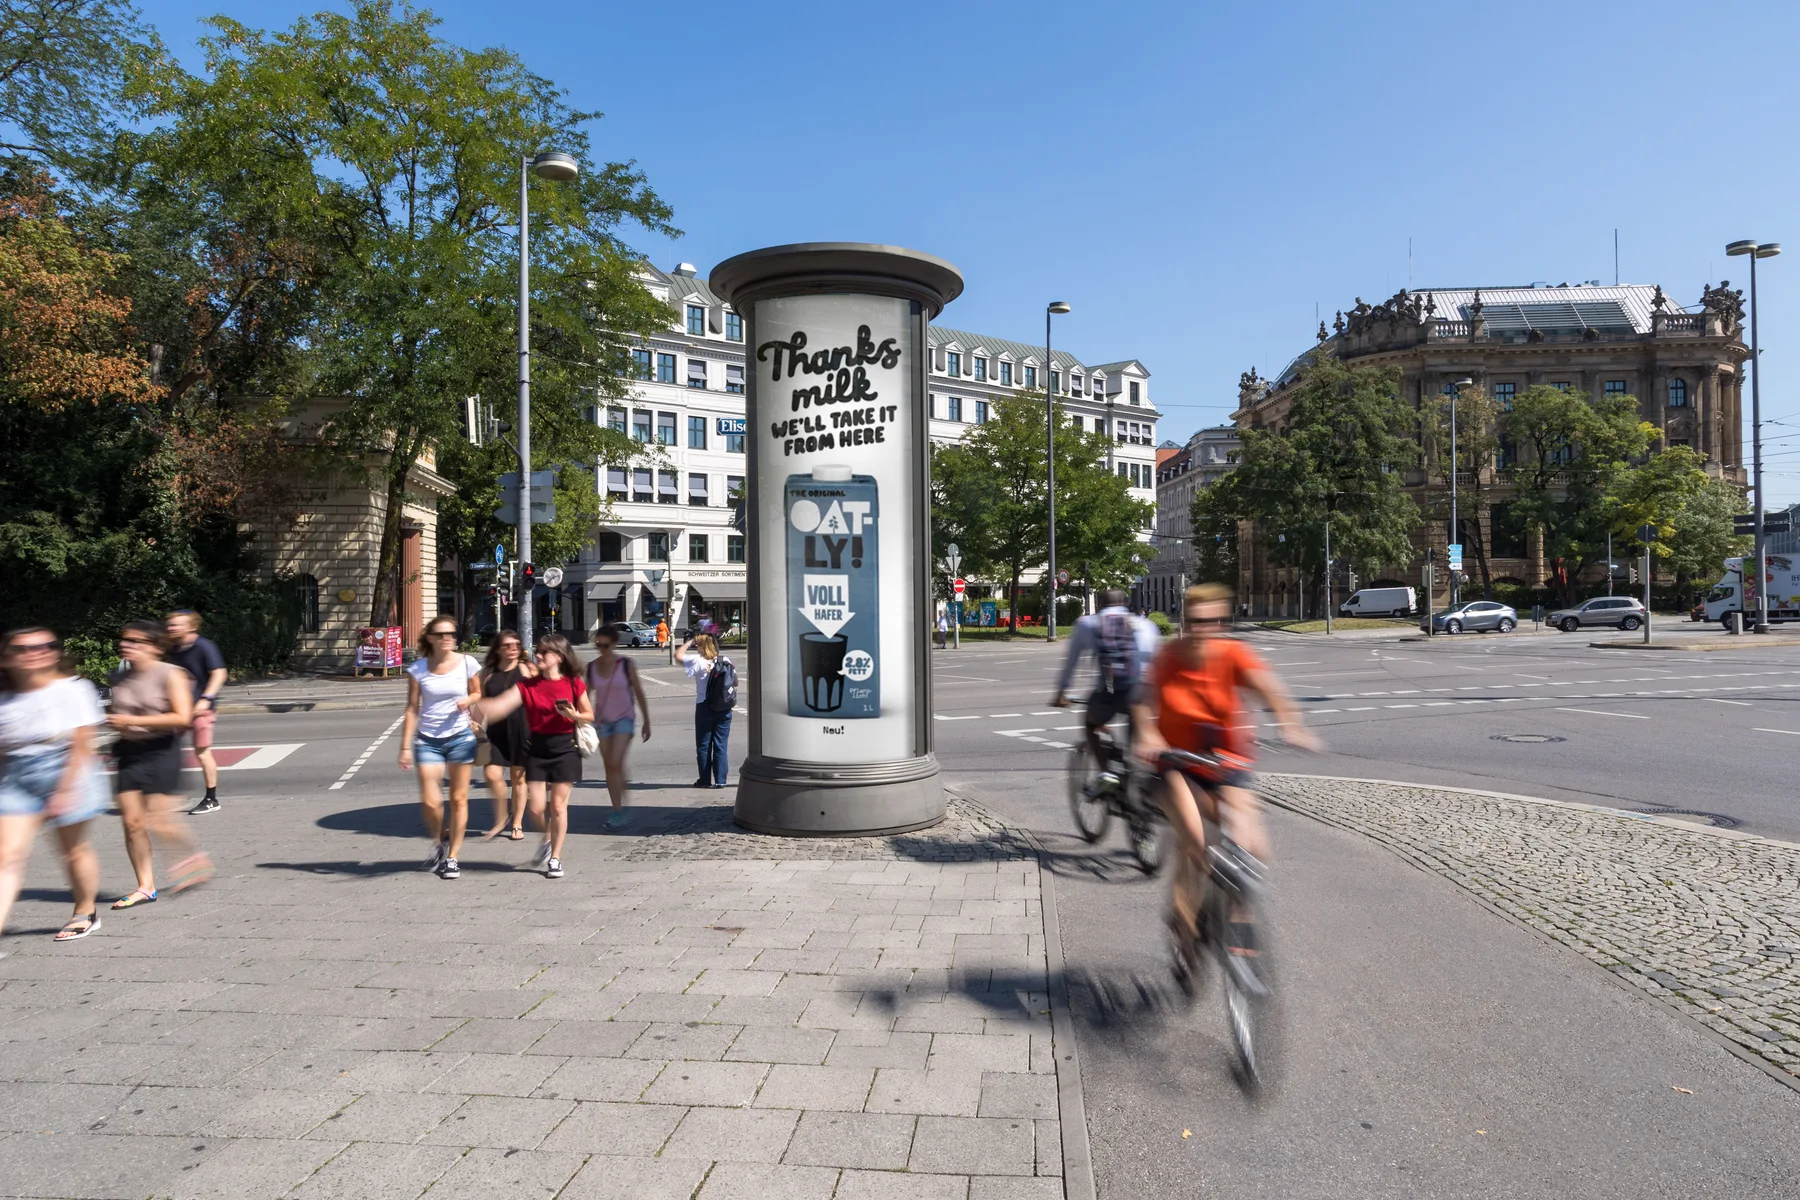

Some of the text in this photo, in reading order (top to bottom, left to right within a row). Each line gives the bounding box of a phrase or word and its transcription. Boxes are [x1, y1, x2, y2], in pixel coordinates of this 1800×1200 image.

[757, 324, 901, 381] Thanks
[791, 366, 878, 412] milk
[771, 405, 897, 439] WE'LL TAKE IT
[784, 426, 885, 456] FROM HERE
[808, 489, 846, 497] ORIGINAL
[804, 535, 864, 569] LY!
[807, 585, 846, 606] VOLL
[814, 608, 843, 621] HAFER
[844, 656, 870, 669] 2.8%
[822, 725, 845, 735] Neu!
